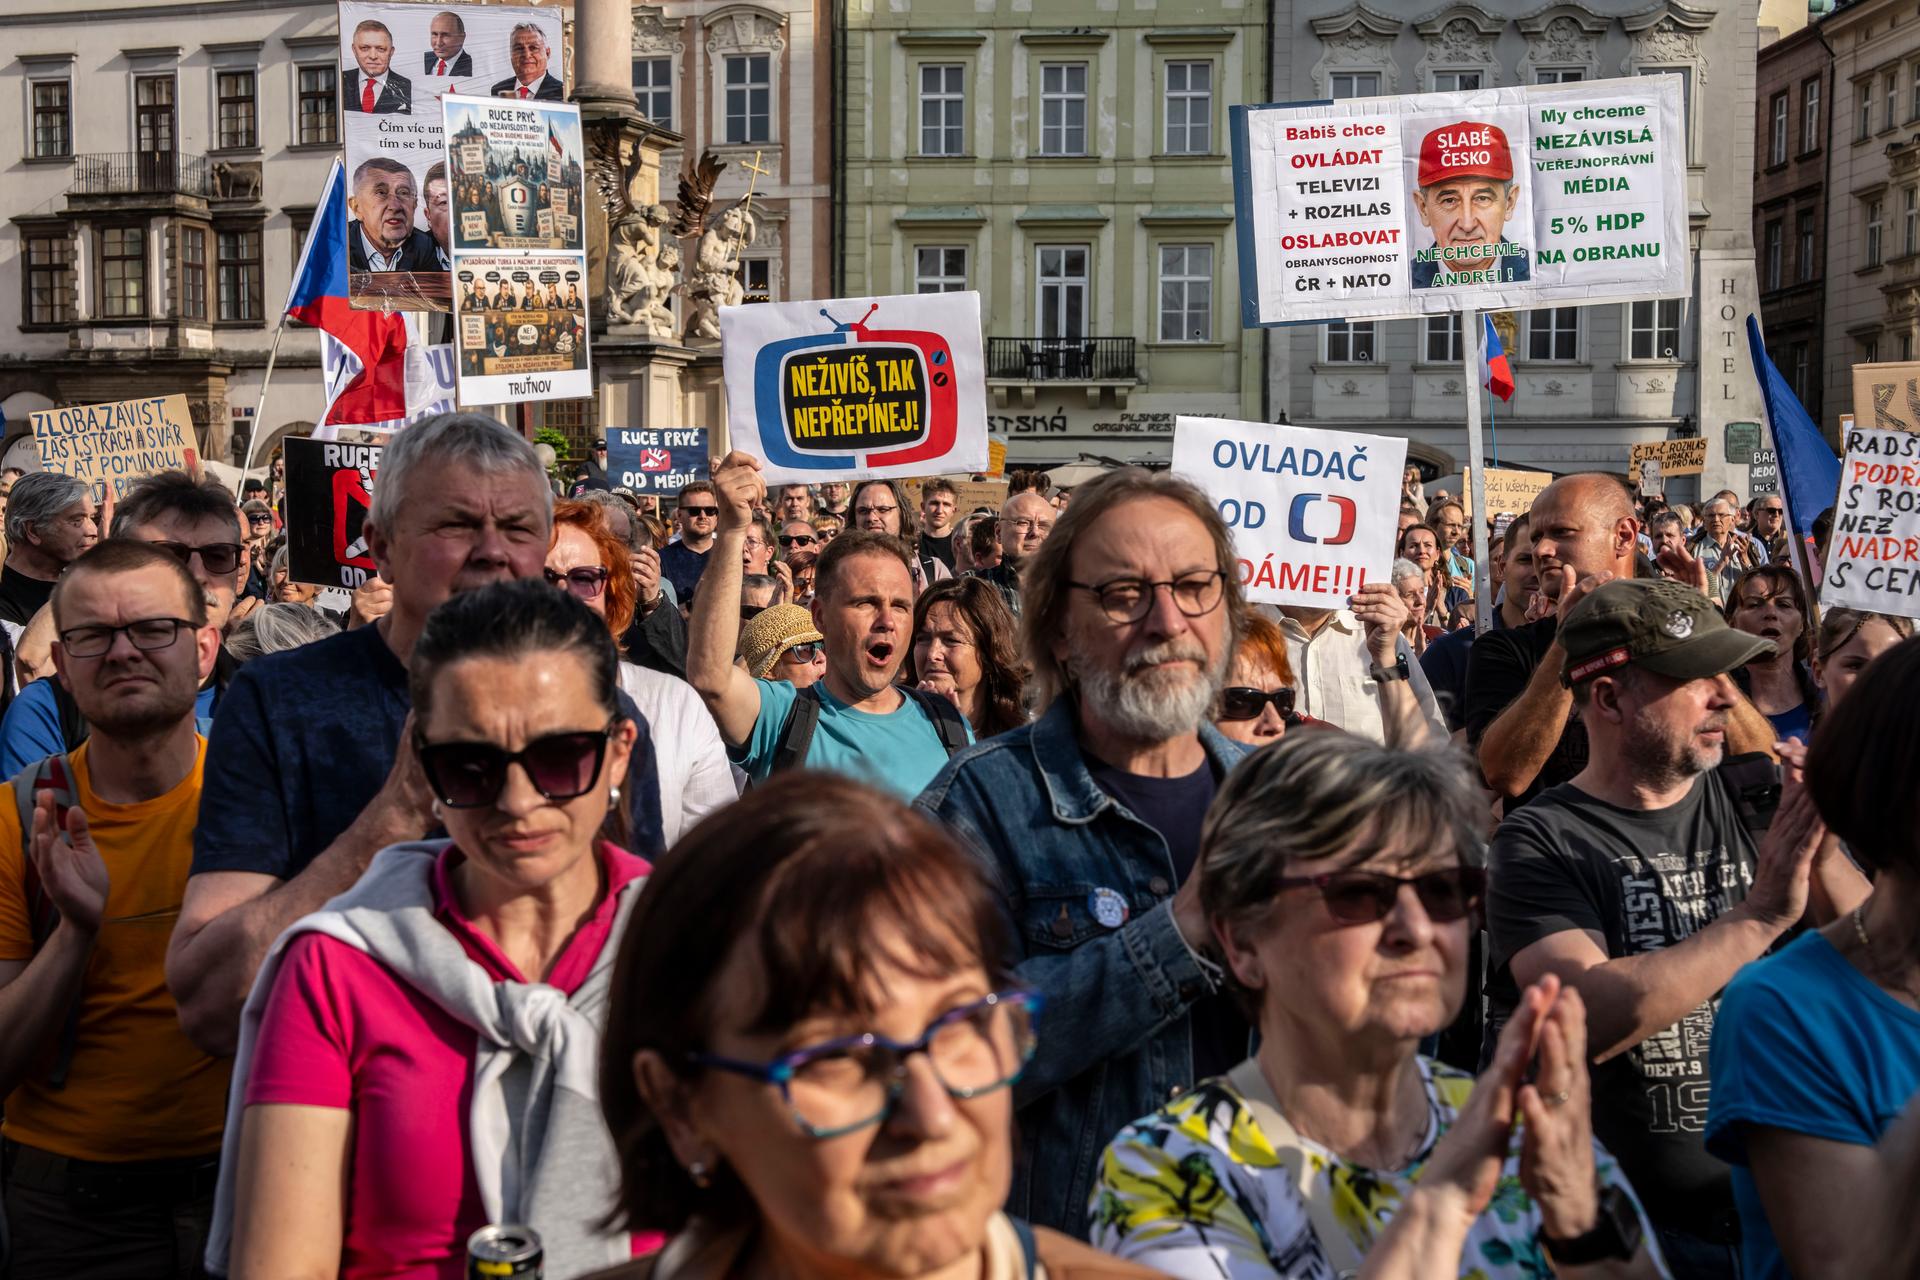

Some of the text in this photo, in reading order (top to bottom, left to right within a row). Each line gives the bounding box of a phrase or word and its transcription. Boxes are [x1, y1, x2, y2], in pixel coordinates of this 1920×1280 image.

[489, 109, 512, 121] RUCE
[1541, 105, 1645, 125] My chceme
[379, 119, 404, 132] Čím
[407, 123, 424, 133] víc
[1286, 124, 1386, 140] Babiš chce
[379, 138, 399, 148] tím
[403, 141, 415, 149] se
[1437, 127, 1490, 148] SLABÉ
[1536, 125, 1654, 150] NEZÁVISLÁ
[1291, 149, 1383, 169] OVLÁDAT
[1441, 150, 1490, 167] ČESKO
[1536, 152, 1654, 172] VEŘEJNOPRÁVNÍ
[1296, 177, 1379, 194] TELEVIZI
[1564, 176, 1630, 195] MÉDIA
[1288, 202, 1391, 219] + ROZHLAS
[1596, 212, 1645, 231] HDP
[1281, 230, 1400, 250] OSLABOVAT
[1286, 254, 1399, 268] OBRANYSCHOPNOST
[1417, 243, 1526, 262] NECHCEME,
[1537, 242, 1660, 265] NA OBRANU
[1295, 273, 1391, 292] ČR + NATO
[1432, 269, 1502, 286] ANDREI
[1721, 279, 1736, 400] HOTEL
[791, 354, 916, 397] NEŽIVÍŠ, TAK
[794, 398, 920, 438] NEPŘEPÍNEJ!
[1120, 413, 1170, 422] PILSNER
[621, 428, 700, 446] RUCE PRYČ
[1093, 423, 1144, 432] ORIGINAL
[82, 428, 134, 457] STRACH
[136, 428, 146, 449] A
[146, 422, 185, 448] SVÁR
[1669, 440, 1706, 453] ROZHLAS
[1849, 430, 1920, 456] RADŠ
[324, 444, 382, 468] RUCE
[1213, 439, 1368, 482] OVLADAČ
[1672, 459, 1687, 468] PRO
[622, 471, 647, 488] OD
[1849, 459, 1920, 486] "PODŘ
[1506, 478, 1530, 493] všech
[1511, 498, 1519, 508] si
[1844, 484, 1863, 510] S
[1218, 499, 1266, 529] OD
[1838, 511, 1900, 535] NEŽ
[341, 565, 367, 589] OD
[1829, 561, 1852, 589] S
